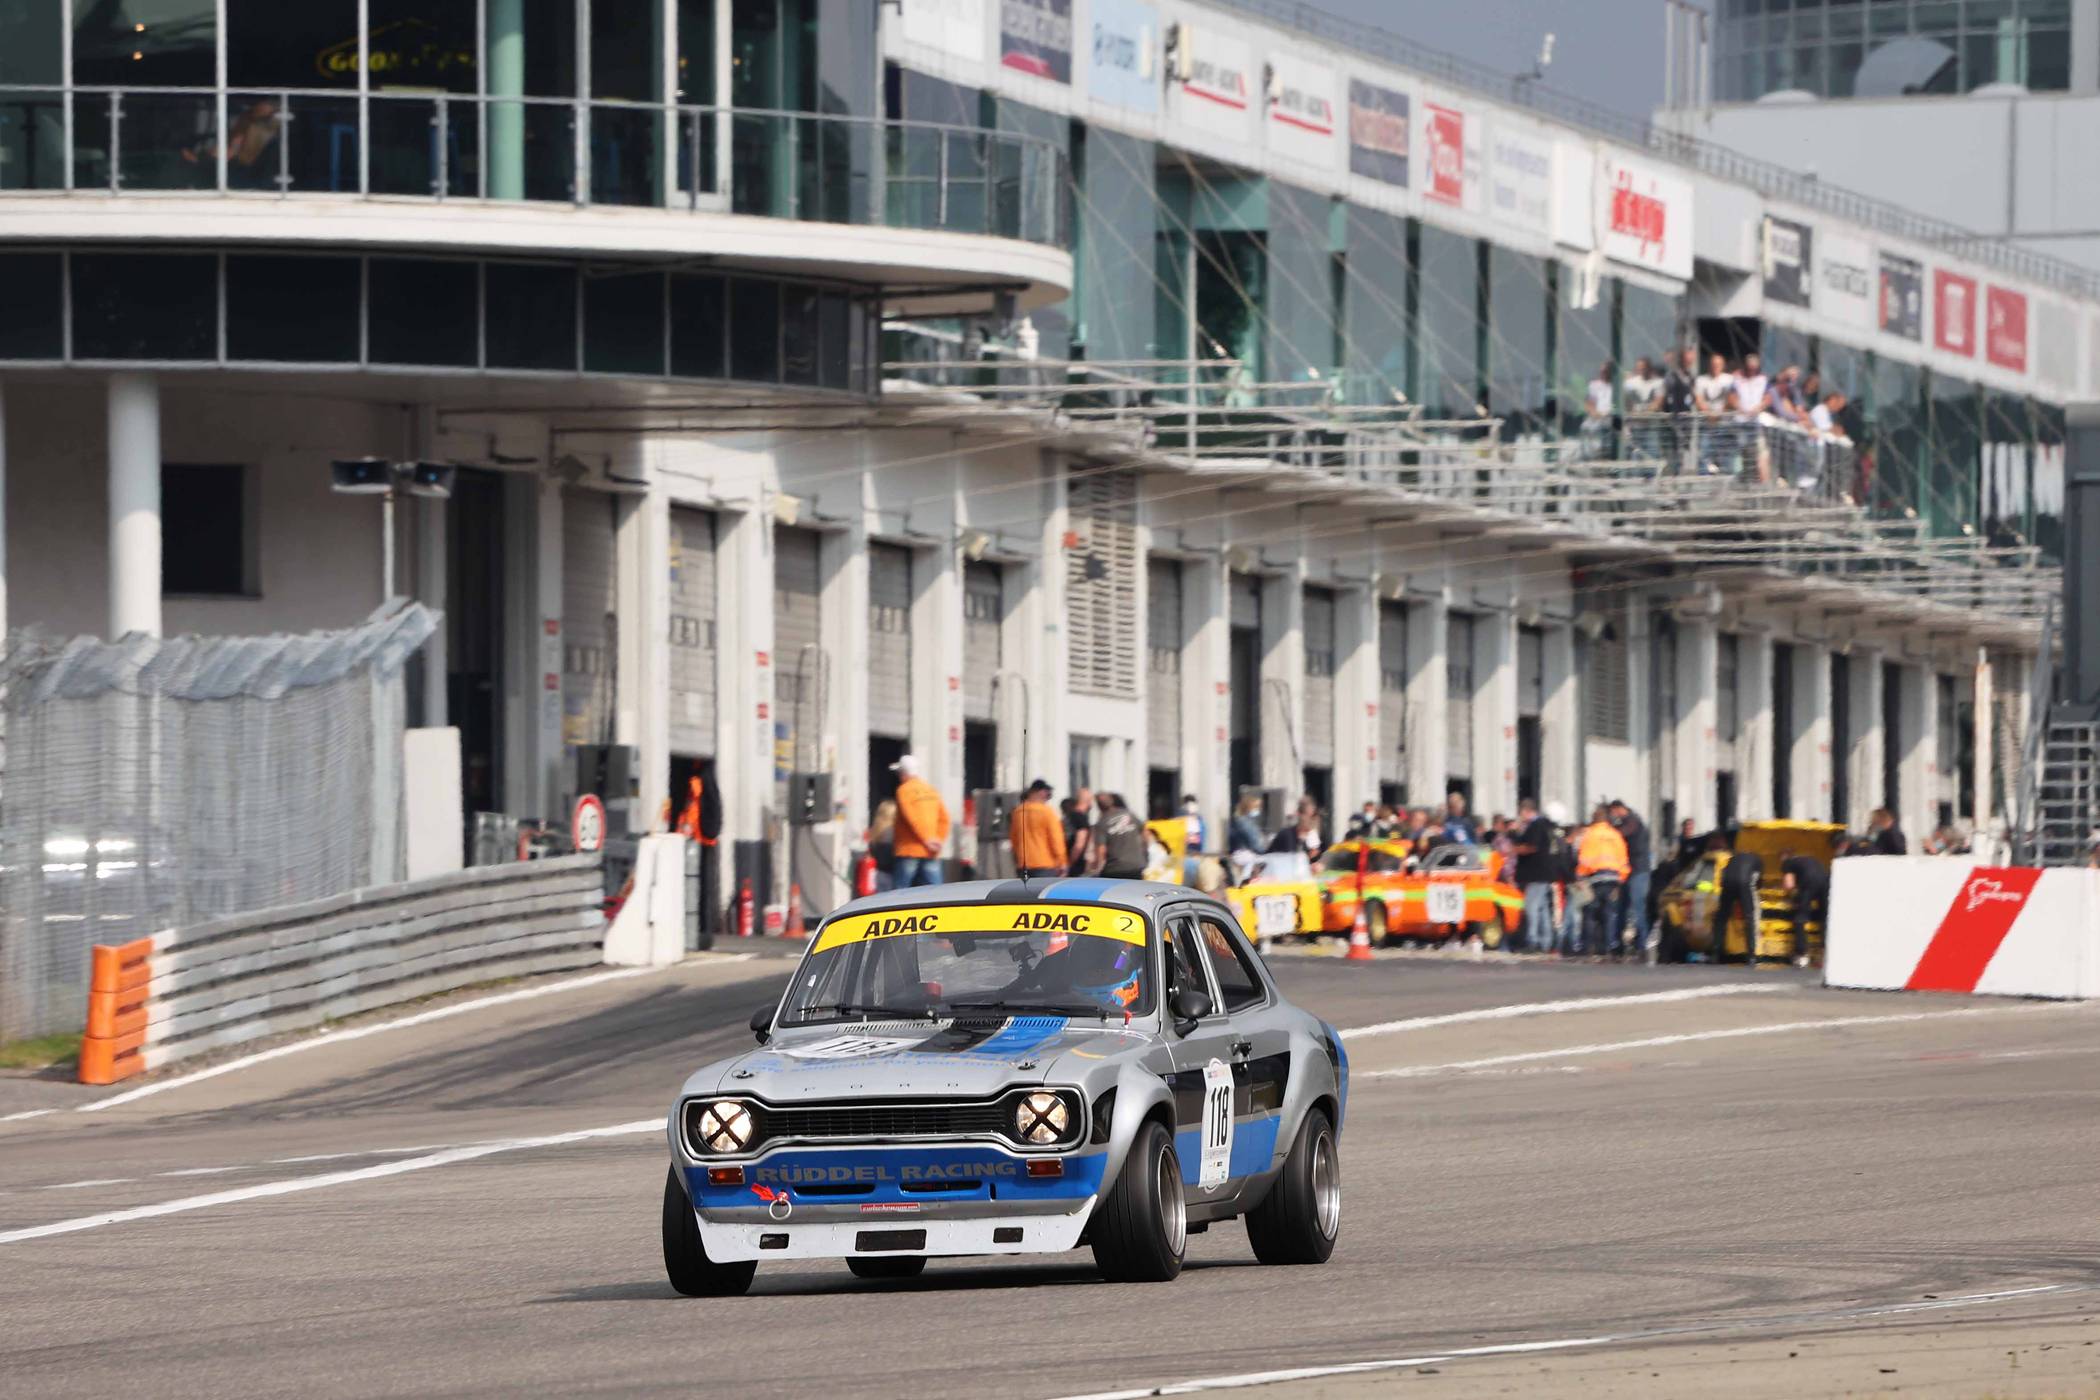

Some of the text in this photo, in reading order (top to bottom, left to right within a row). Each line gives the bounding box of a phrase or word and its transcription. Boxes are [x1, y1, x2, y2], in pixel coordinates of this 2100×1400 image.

[863, 915, 938, 938] ADAC
[1012, 912, 1090, 932] ADAC
[1118, 916, 1133, 932] 2
[1209, 1085, 1230, 1148] 118
[755, 1161, 1017, 1184] RÜDDEL RACING
